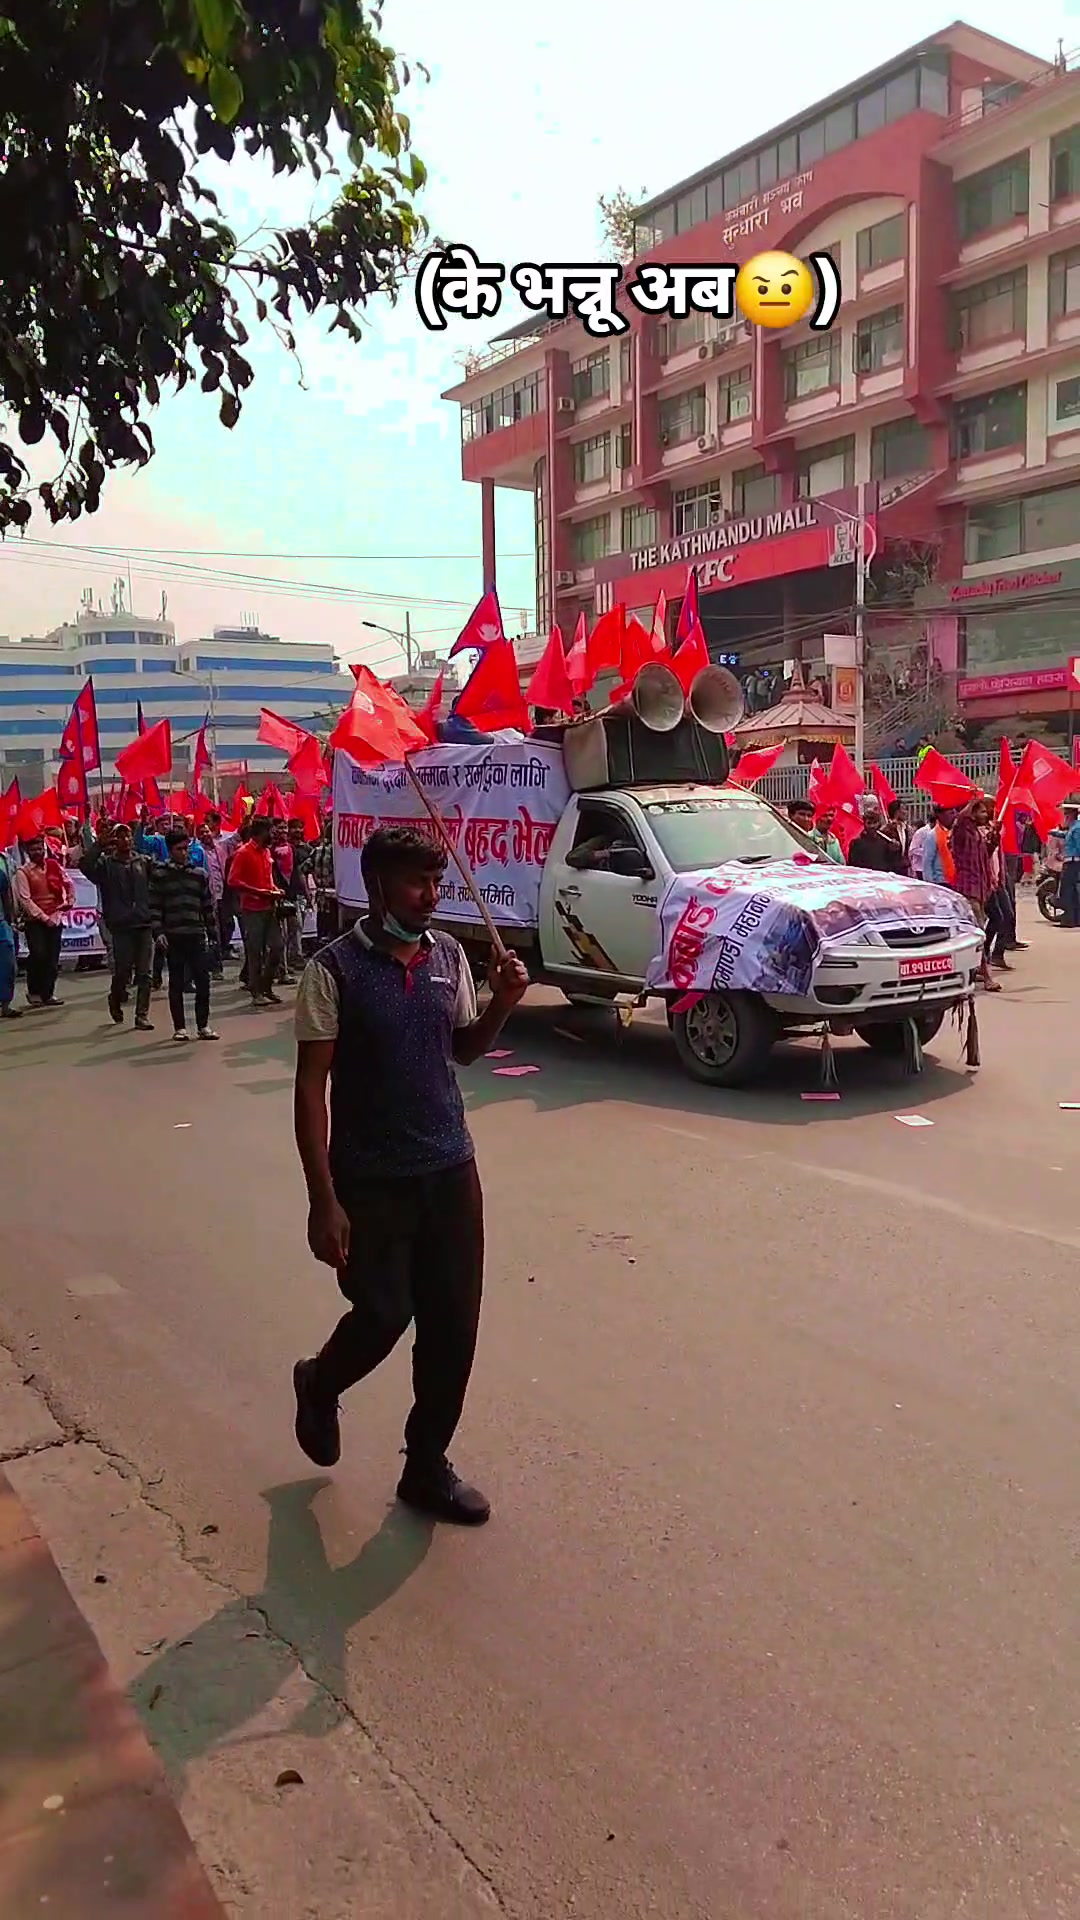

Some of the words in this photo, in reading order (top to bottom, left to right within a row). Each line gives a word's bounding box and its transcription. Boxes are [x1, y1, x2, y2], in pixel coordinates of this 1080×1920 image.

[630, 552, 657, 571] THE
[660, 522, 763, 564] KATHMANDU
[766, 503, 817, 536] MALL
[690, 555, 736, 588] KFC
[833, 552, 852, 564] KFC
[452, 765, 461, 788] र
[510, 757, 551, 788] लागि
